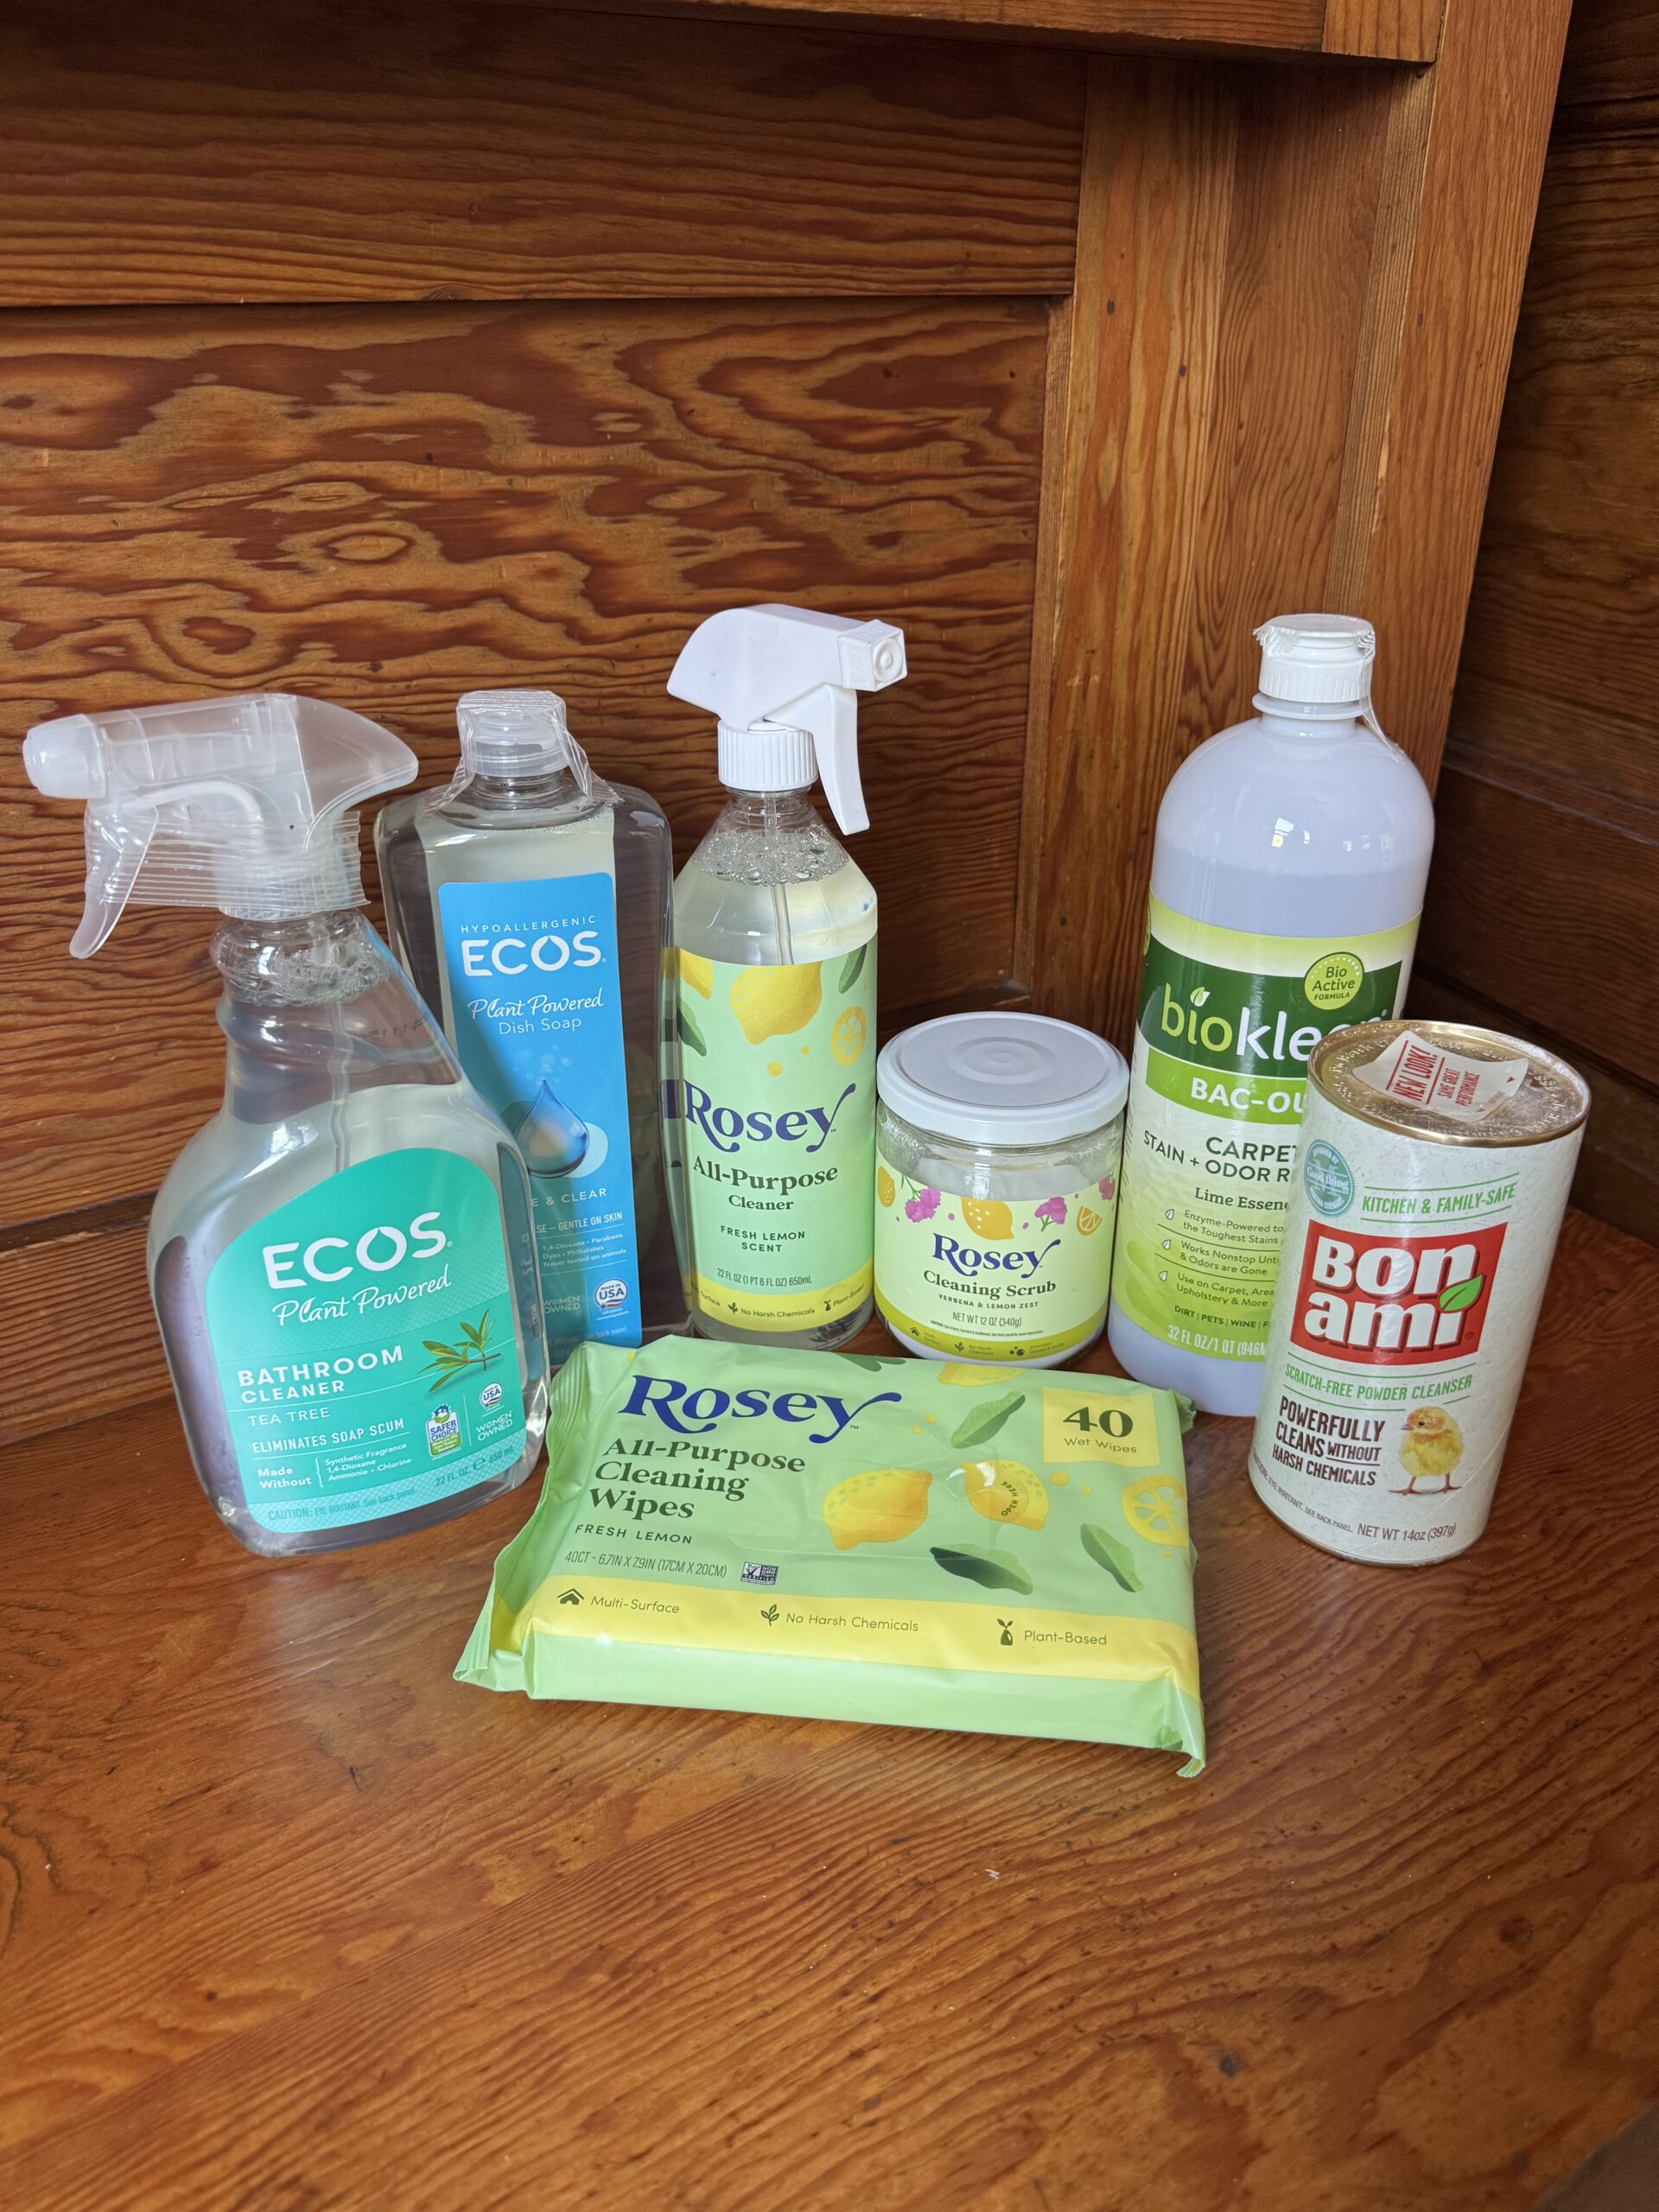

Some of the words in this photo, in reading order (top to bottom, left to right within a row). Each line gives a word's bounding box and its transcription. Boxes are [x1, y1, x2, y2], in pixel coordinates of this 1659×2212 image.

[461, 915, 595, 934] HYPOALLERGENIC
[1325, 966, 1347, 978] Bio
[1312, 979, 1356, 993] Active
[1313, 992, 1351, 1001] FORMULA
[467, 998, 526, 1020] Plant
[526, 988, 604, 1016] Powered
[499, 1020, 535, 1035] Dish
[541, 1017, 582, 1033] Soap
[1161, 982, 1381, 1061] biokle
[1402, 1045, 1438, 1079] LOOK!
[1392, 1074, 1427, 1102] NEW
[1441, 1068, 1460, 1085] GREAT
[1455, 1071, 1480, 1107] PERFORMANCE
[683, 1078, 856, 1153] Rosey
[1143, 1129, 1185, 1165] STAIN
[1205, 1160, 1270, 1182] ODOR
[693, 1155, 838, 1196] All-Purpose
[1306, 1166, 1325, 1183] Good
[1325, 1171, 1349, 1192] thing
[545, 1196, 555, 1205] &
[562, 1188, 607, 1203] CLEAR
[728, 1194, 794, 1211] Cleaner
[1194, 1187, 1234, 1207] Lime
[1362, 1195, 1417, 1215] KITCHEN
[1421, 1199, 1432, 1214] &
[1436, 1182, 1518, 1213] FAMILY-SAFE
[558, 1217, 588, 1231] GENTLE
[590, 1216, 601, 1225] ON
[603, 1211, 623, 1223] SKIN
[1184, 1209, 1270, 1232] Enzyme-Powered
[721, 1224, 757, 1240] FRESH
[763, 1230, 805, 1241] LEMON
[1183, 1221, 1198, 1232] the
[1200, 1225, 1246, 1243] Toughest
[1249, 1234, 1279, 1244] Stains
[741, 1242, 783, 1252] SCENT
[932, 1232, 1061, 1279] Rosey
[1181, 1240, 1210, 1256] Works
[1212, 1249, 1256, 1264] Nonstop
[1179, 1252, 1187, 1261] &
[1188, 1255, 1219, 1270] Odors
[1221, 1262, 1237, 1274] are
[1240, 1265, 1268, 1275] Gone
[1313, 1236, 1477, 1295] Bon
[715, 1268, 725, 1279] 22
[725, 1271, 734, 1281] FL
[734, 1274, 742, 1283] OZ
[750, 1276, 759, 1286] PT
[760, 1276, 765, 1287] 6
[766, 1277, 774, 1287] FL
[775, 1276, 787, 1287] OZ)
[789, 1274, 812, 1286] 650mL
[923, 1269, 1002, 1300] Cleaning
[1006, 1280, 1056, 1297] Scrub
[1178, 1271, 1194, 1284] Use
[1197, 1280, 1209, 1289] on
[1211, 1282, 1249, 1296] Carpet,
[1250, 1287, 1274, 1296] Area
[272, 1296, 350, 1326] Plant
[352, 1264, 452, 1314] Powered
[543, 1295, 581, 1306] WOMEN
[599, 1287, 625, 1300] USA
[938, 1294, 975, 1307] VERBENA
[1176, 1283, 1229, 1307] Upholstery
[1241, 1298, 1268, 1306] More
[543, 1302, 581, 1313] OWNED
[753, 1309, 775, 1318] Harsh
[777, 1307, 815, 1318] Chemicals
[1174, 1305, 1196, 1319] DIRT
[1201, 1313, 1224, 1325] PETS
[1230, 1319, 1256, 1328] WINE
[952, 1311, 966, 1322] NET
[967, 1313, 979, 1325] WT
[979, 1315, 987, 1325] 12
[988, 1317, 998, 1326] OZ
[999, 1317, 1022, 1328] (340g)
[1304, 1291, 1466, 1348] ami
[1168, 1324, 1178, 1339] 32
[1181, 1330, 1191, 1344] FL
[1222, 1340, 1236, 1354] QT
[238, 1345, 404, 1386] BATHROOM
[241, 1380, 345, 1403] CLEANER
[1285, 1363, 1353, 1399] SCRATCH-FREE
[1356, 1385, 1408, 1401] POWDER
[1411, 1375, 1472, 1399] CLEANSER
[483, 1388, 501, 1401] USA
[247, 1414, 282, 1426] TEA
[287, 1408, 330, 1422] TREE
[618, 1375, 902, 1444] Rosey
[1279, 1395, 1386, 1442] POWERFULLY
[430, 1420, 456, 1434] SAFER
[476, 1410, 512, 1433] WOMEN
[477, 1419, 513, 1441] OWNED
[1063, 1407, 1134, 1438] 40
[252, 1434, 327, 1453] ELIMINATES
[332, 1428, 364, 1443] SOAP
[370, 1418, 404, 1436] SCUM
[431, 1427, 457, 1441] CHOICE
[1064, 1437, 1090, 1447] Wet
[1096, 1440, 1137, 1454] Wipes
[1275, 1421, 1325, 1458] CLEANS
[1327, 1441, 1382, 1461] WITHOUT
[325, 1453, 365, 1466] Synthetic
[366, 1443, 407, 1458] Fragrance
[327, 1459, 377, 1473] 1,4-Dioxane
[602, 1438, 806, 1472] All-Purpose
[1272, 1443, 1304, 1471] HARSH
[1306, 1460, 1376, 1485] CHEMICALS
[257, 1465, 294, 1477] Made
[328, 1469, 369, 1481] Ammonia
[378, 1458, 412, 1471] Chlorine
[435, 1476, 446, 1486] 22
[489, 1451, 503, 1463] 650
[260, 1477, 312, 1490] Without
[595, 1461, 749, 1501] Cleaning
[1001, 1481, 1019, 1497] HERE
[269, 1506, 313, 1521] CAUTION:
[590, 1488, 695, 1520] Wipes
[1001, 1500, 1019, 1516] OPEN
[1278, 1485, 1304, 1511] IRRITANT.
[1304, 1506, 1316, 1518] SEE
[1316, 1512, 1332, 1526] BACK
[575, 1524, 627, 1538] FRESH
[636, 1530, 692, 1544] LEMON
[1357, 1522, 1380, 1539] NET
[1382, 1526, 1400, 1541] WT
[1402, 1527, 1425, 1541] 14oz
[1427, 1522, 1457, 1541] (397g)
[565, 1551, 590, 1564] 40CT
[624, 1556, 632, 1567] X
[658, 1558, 684, 1573] (17CM
[686, 1561, 695, 1573] X
[696, 1561, 727, 1579] 20CM)
[591, 1595, 680, 1614] Multi-Surface
[785, 1612, 804, 1624] No
[809, 1614, 847, 1628] Harsh
[851, 1617, 918, 1632] Chemicals
[1024, 1630, 1108, 1646] Plant-Based
